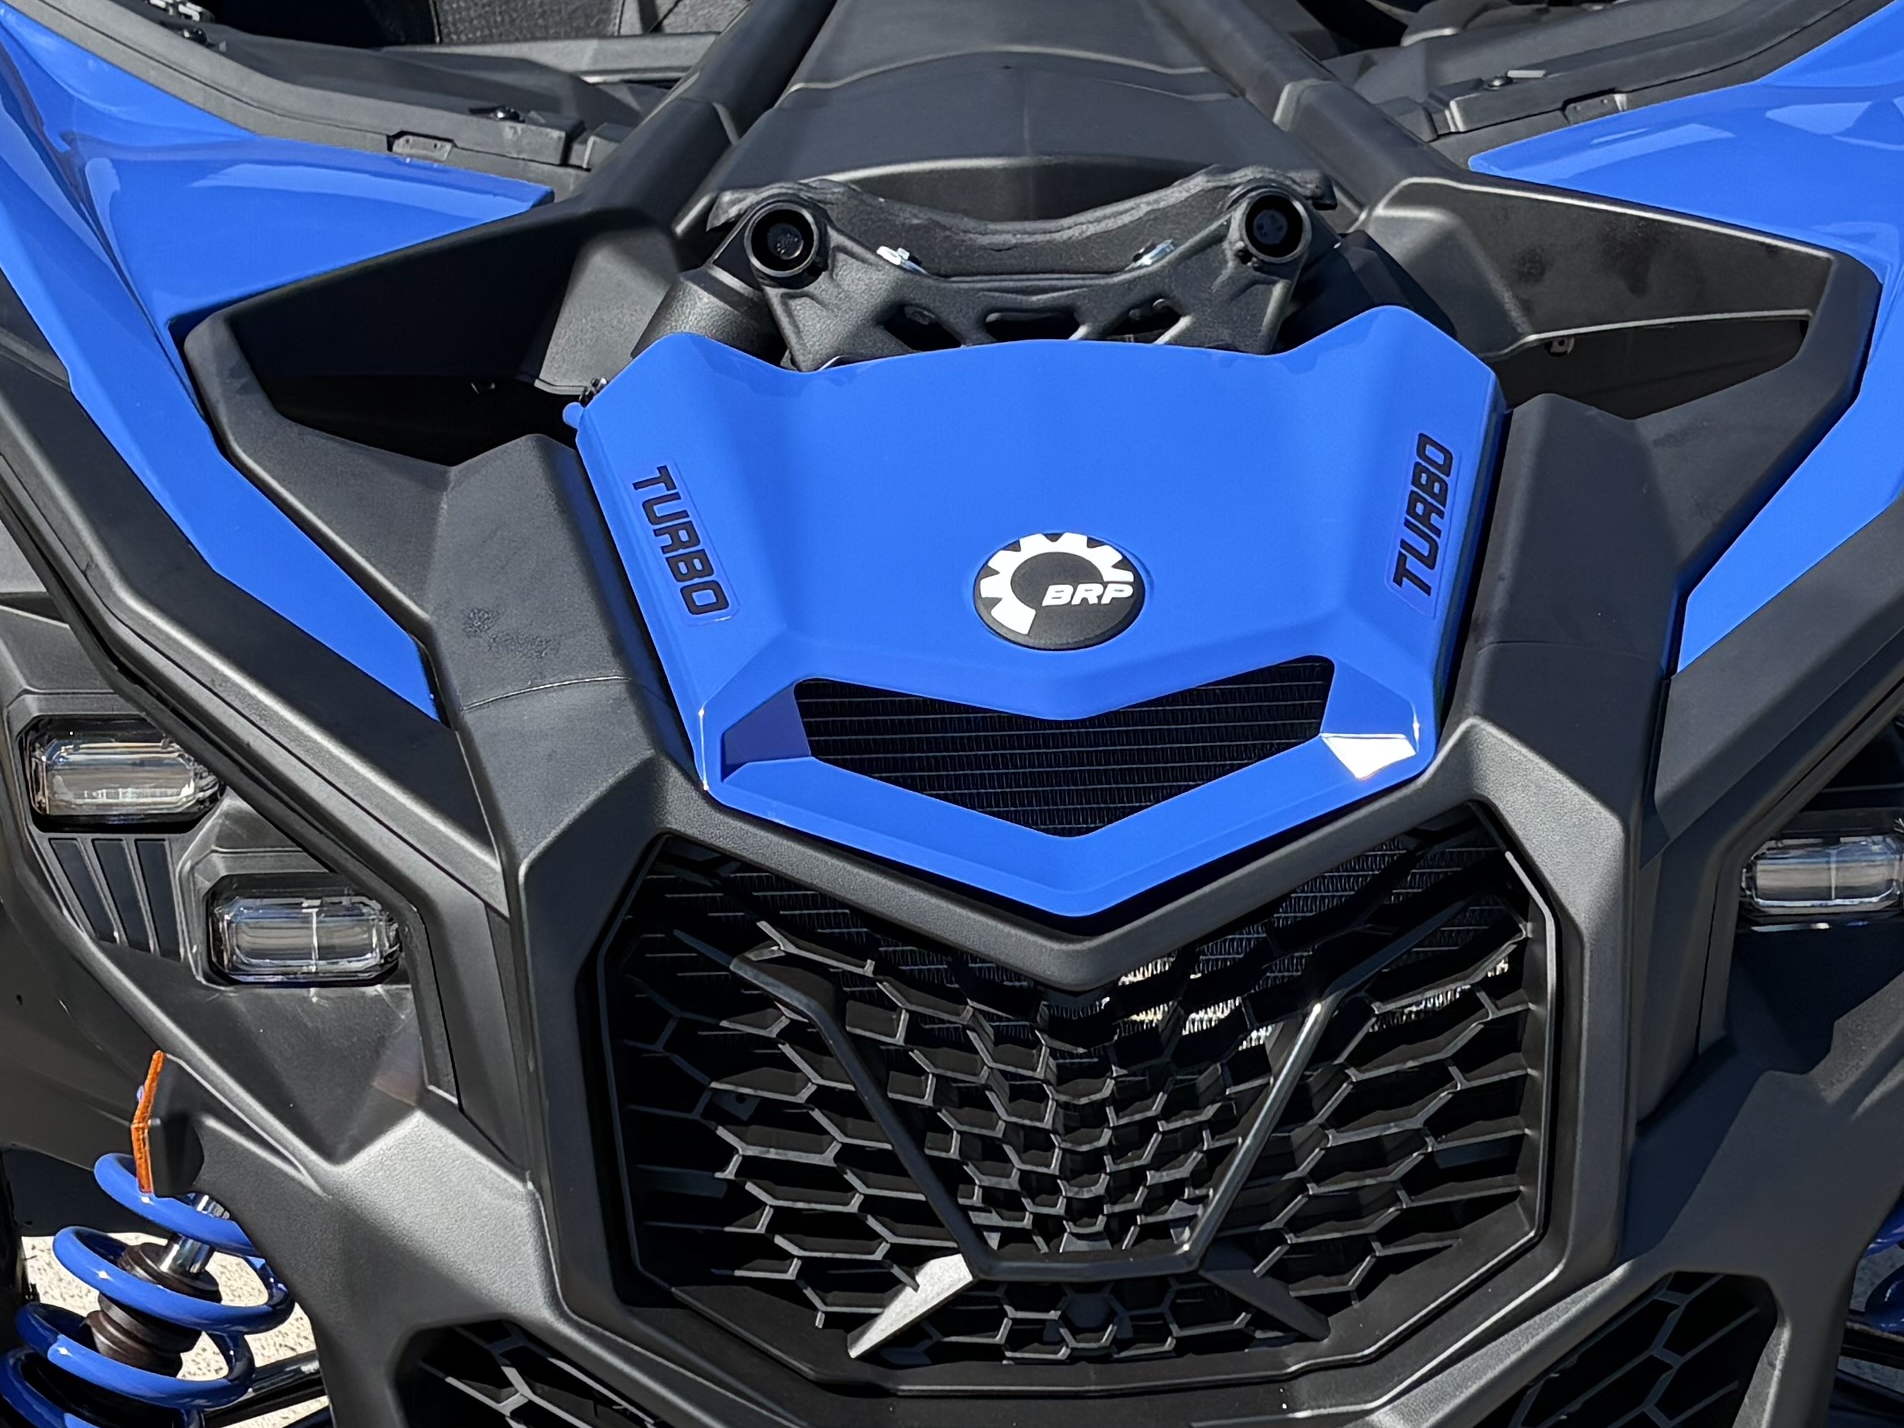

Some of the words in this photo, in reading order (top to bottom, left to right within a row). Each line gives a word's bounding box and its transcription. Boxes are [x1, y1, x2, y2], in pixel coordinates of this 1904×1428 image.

[632, 465, 730, 616] TURBO
[1393, 433, 1453, 597] TURBO
[1041, 583, 1134, 607] BRP
